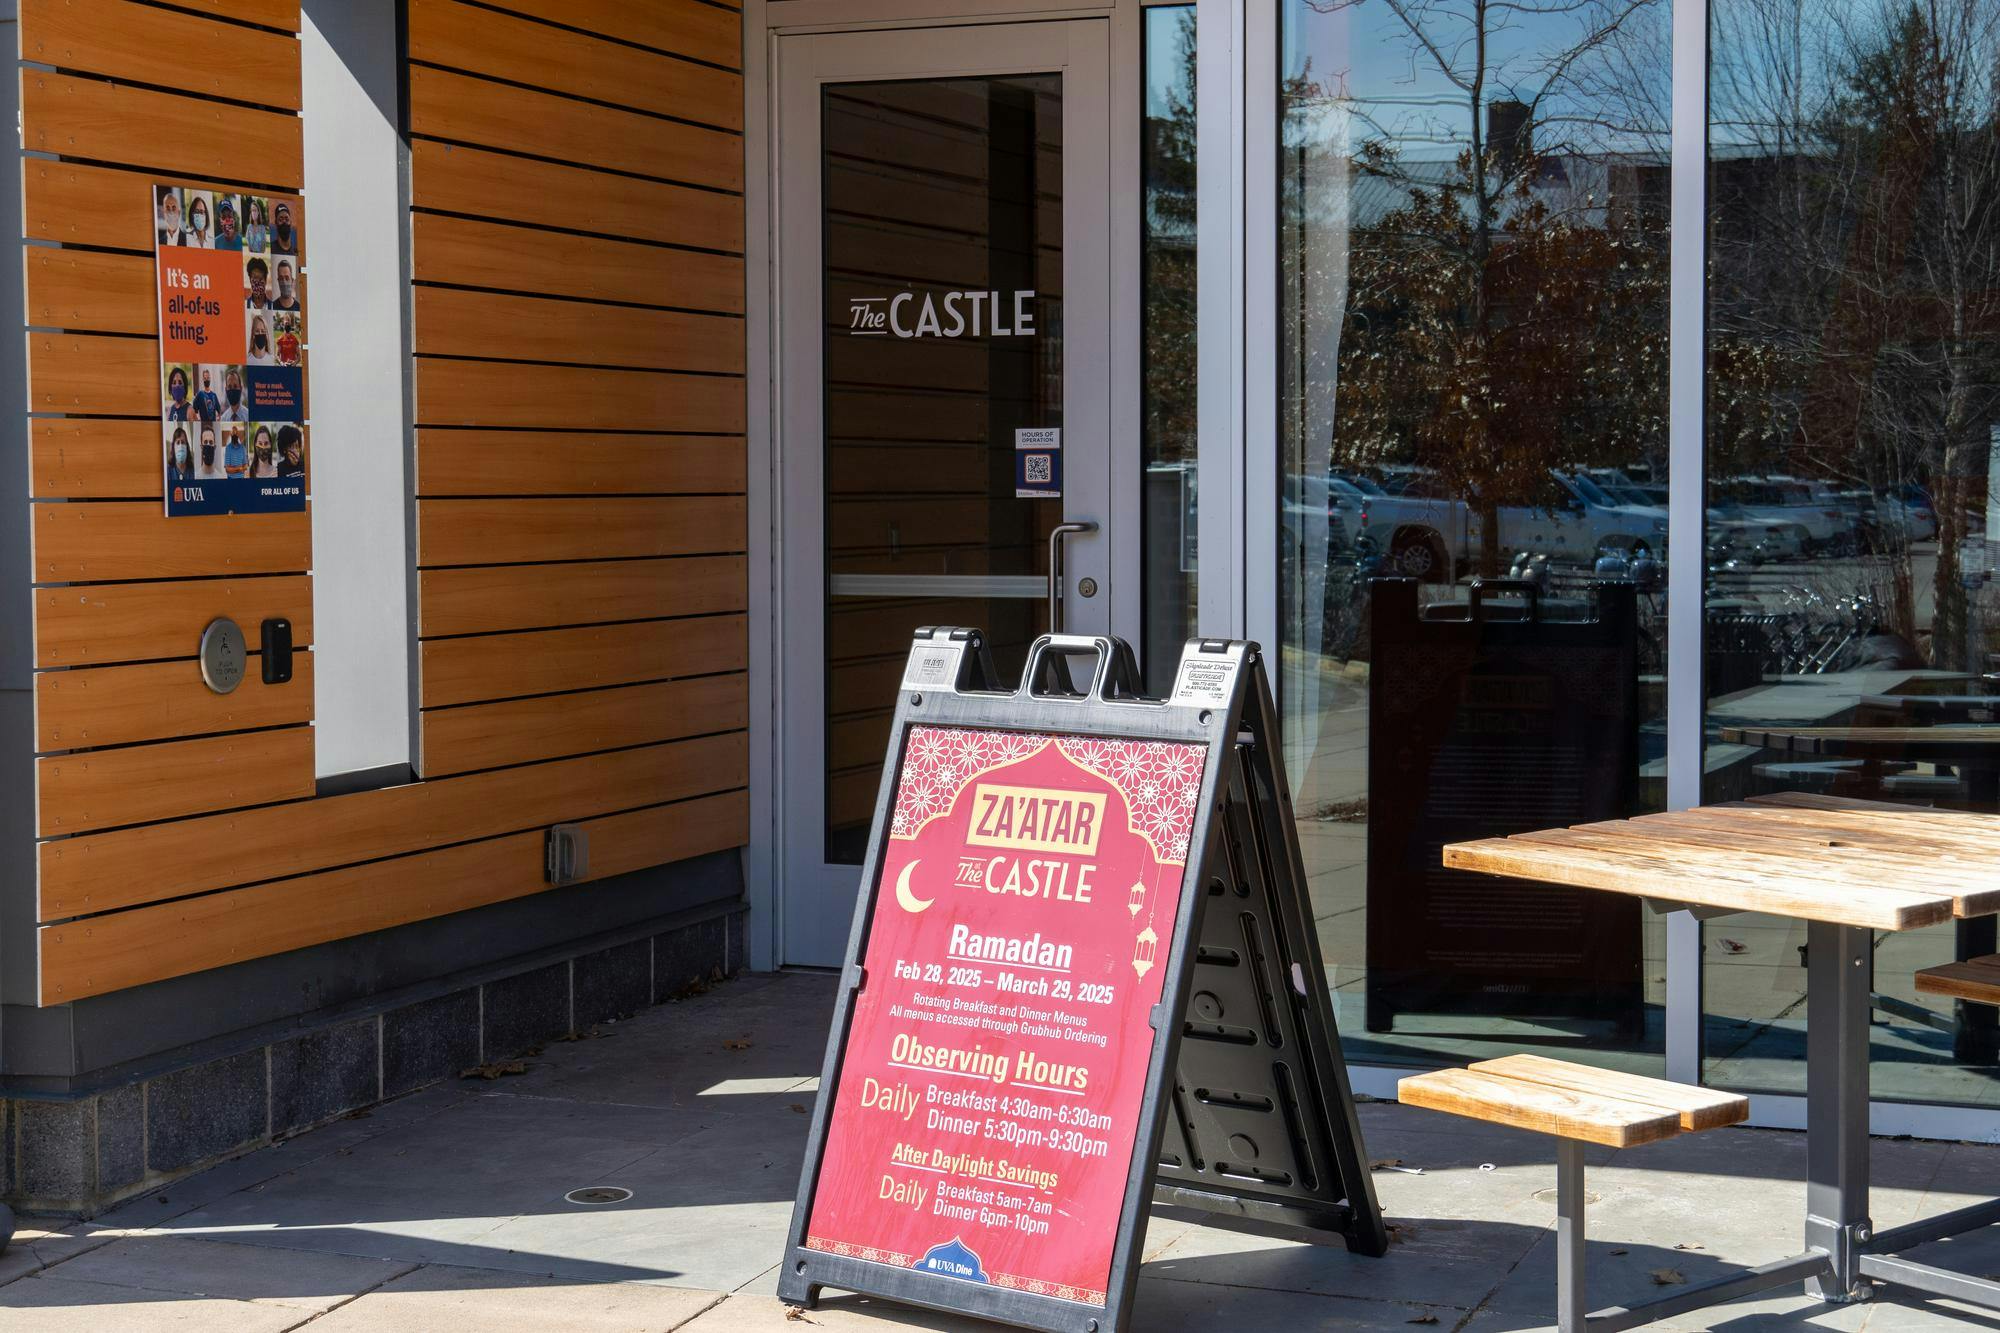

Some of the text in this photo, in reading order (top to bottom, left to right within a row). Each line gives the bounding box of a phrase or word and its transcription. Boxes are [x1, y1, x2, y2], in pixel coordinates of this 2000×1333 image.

[167, 267, 210, 290] It's an
[168, 295, 221, 316] all-of-us
[850, 290, 1036, 338] The CASTLE
[168, 321, 209, 345] thing.
[183, 487, 205, 502] UVA
[261, 487, 299, 496] FOR ALL OF US
[975, 793, 1096, 846] ZA'ATAR
[955, 856, 1097, 903] The CASTLE
[948, 923, 1074, 969] Ramadan
[894, 959, 921, 980] Feb
[923, 963, 944, 986] 28,
[947, 966, 982, 989] 2025
[997, 972, 1048, 997] March
[1050, 979, 1074, 1003] 29,
[1077, 983, 1114, 1005] 2025
[889, 1005, 1108, 1048] All menus accessed through Grubhub Ordering
[913, 992, 1088, 1027] Rotating Breakfast and Dinner Menus
[891, 1033, 1090, 1089] Observing Hours
[860, 1077, 920, 1121] Daily
[926, 1084, 1112, 1130] Breakfast 4:30am-6:30am
[926, 1109, 1109, 1158] Dinner 5:30pm-9:30pm
[891, 1142, 1058, 1190] After Daylight Savings
[879, 1174, 928, 1211] Daily
[936, 1181, 1053, 1215] Breakfast 5am-7am
[933, 1198, 1049, 1235] Dinner 6pm-10pm
[936, 1260, 973, 1276] UVA Dine
